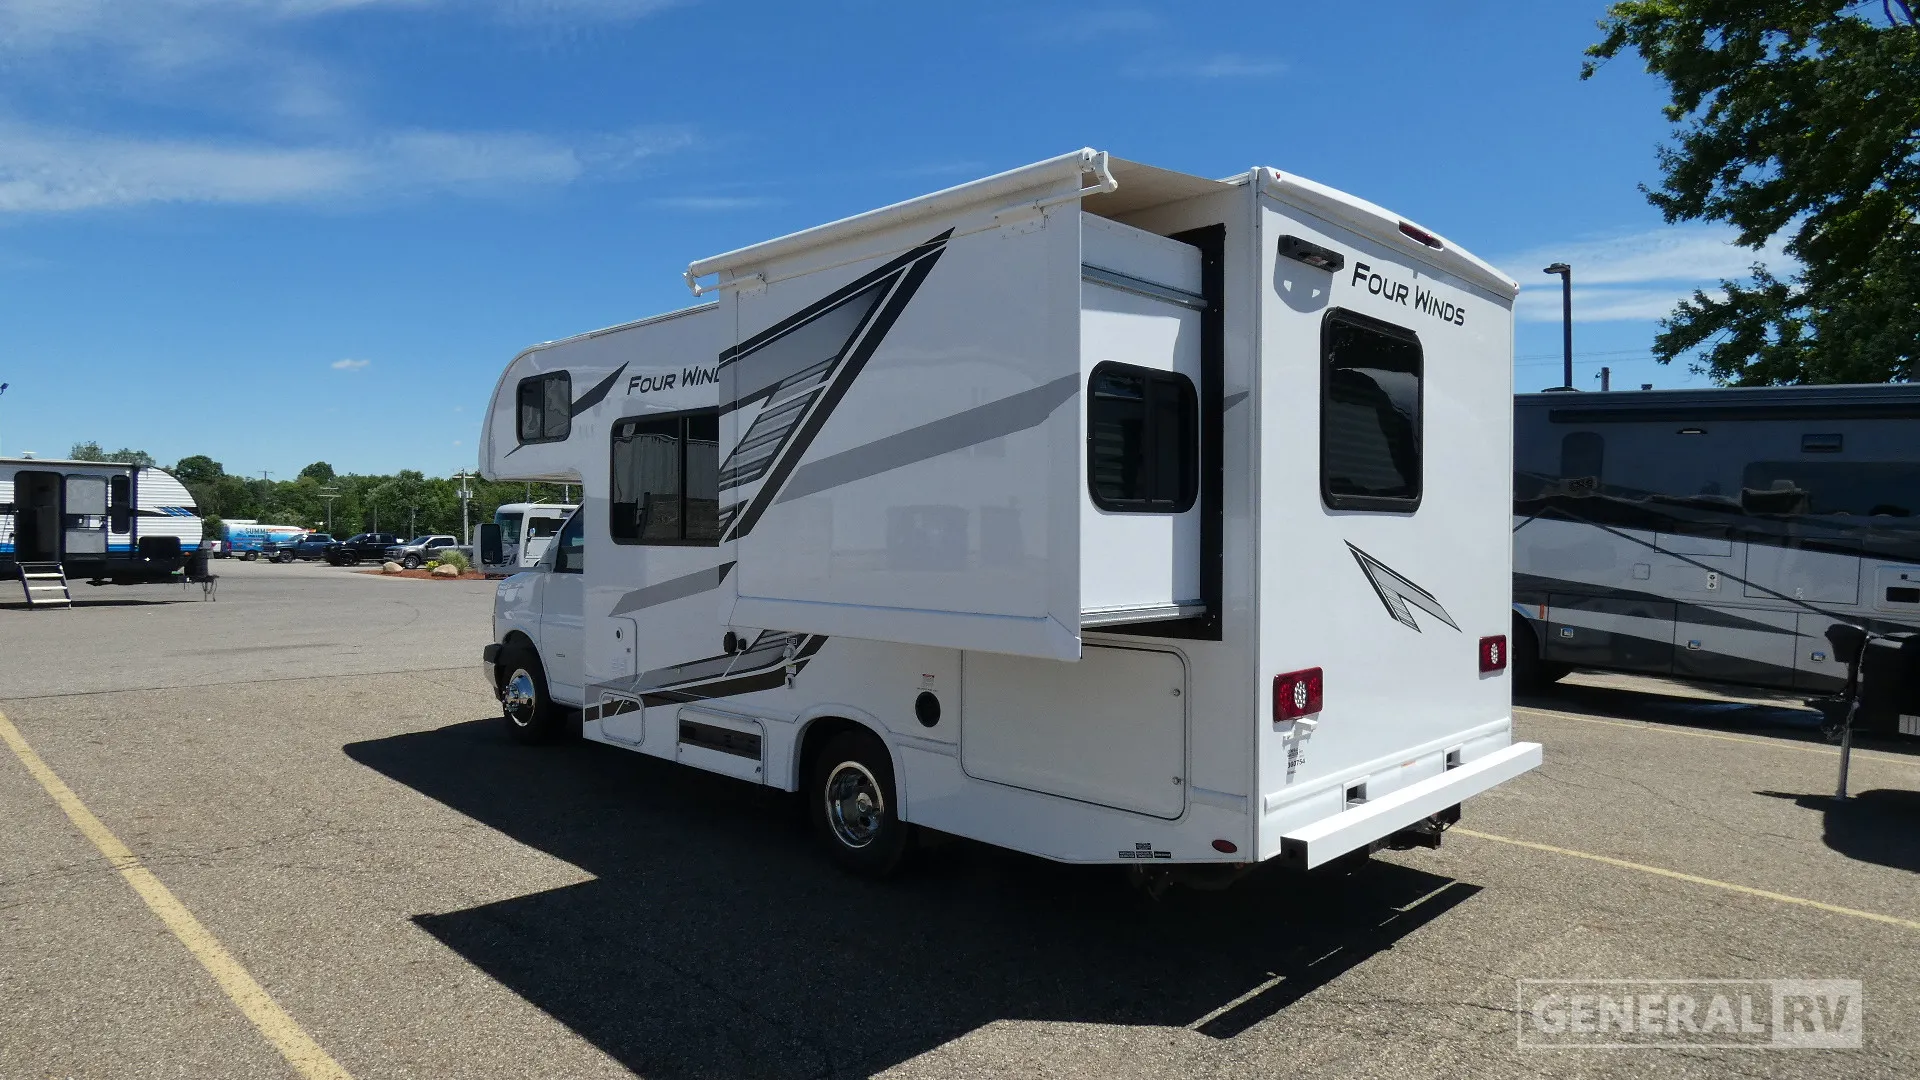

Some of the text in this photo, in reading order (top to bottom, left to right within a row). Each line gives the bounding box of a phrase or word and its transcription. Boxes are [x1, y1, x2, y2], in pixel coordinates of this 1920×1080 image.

[1351, 261, 1465, 327] FOUR WINDS
[626, 373, 676, 396] FOUR
